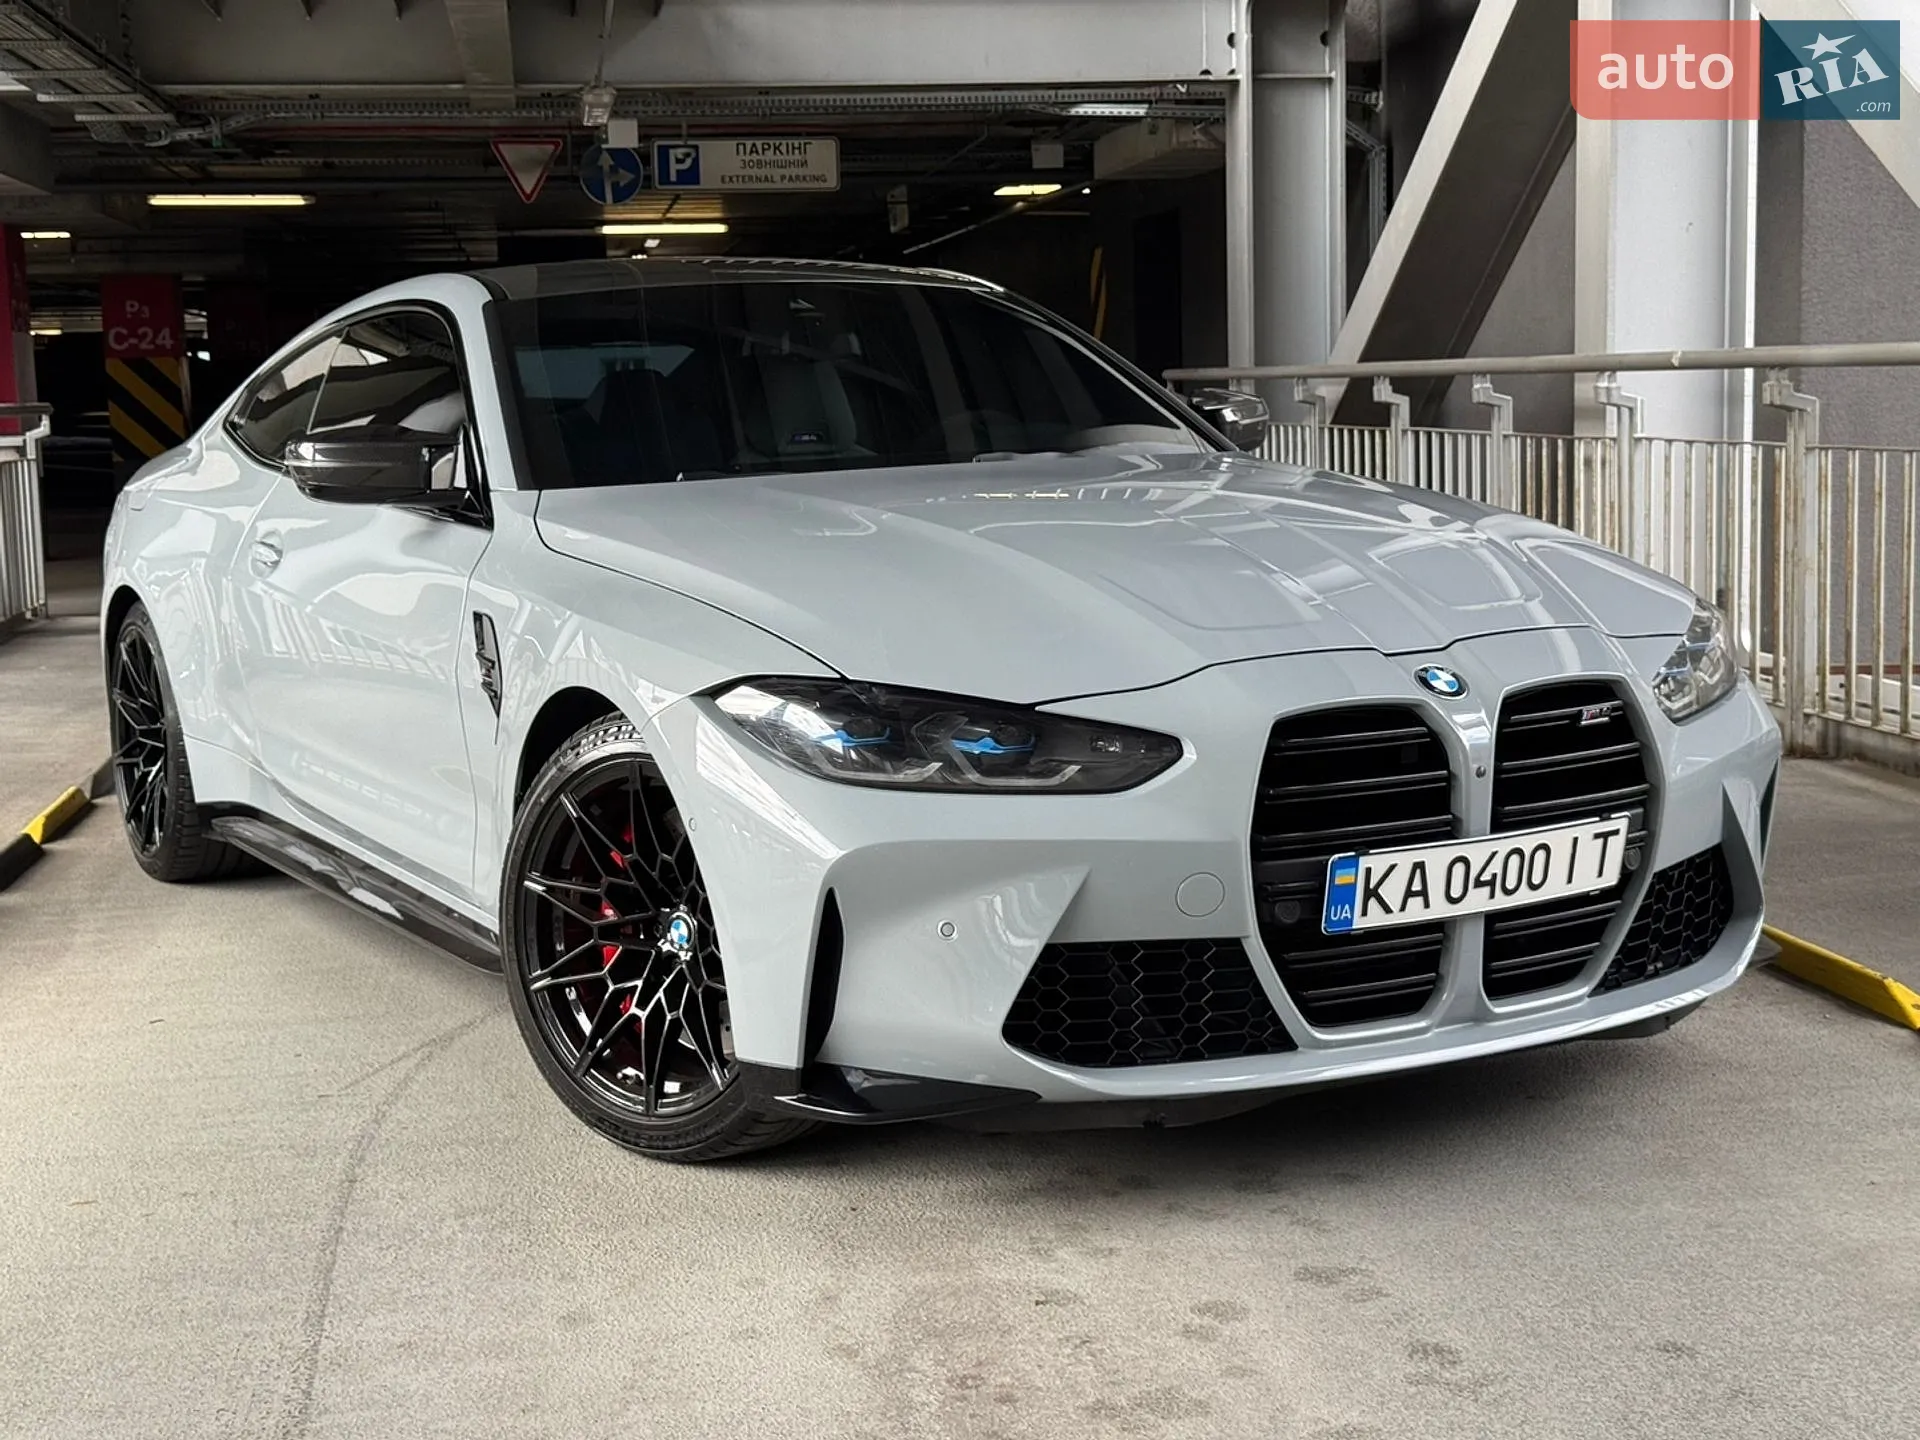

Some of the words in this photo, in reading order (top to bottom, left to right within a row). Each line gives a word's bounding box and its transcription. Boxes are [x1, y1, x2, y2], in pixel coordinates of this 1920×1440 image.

[735, 142, 813, 156] ПАРКІНГ
[669, 148, 697, 182] P
[720, 174, 776, 185] EXTERNAL
[780, 173, 828, 184] PARKING
[107, 326, 174, 351] C-24
[1360, 860, 1431, 917] KA
[1444, 842, 1552, 905] 0400
[1330, 904, 1351, 921] UA
